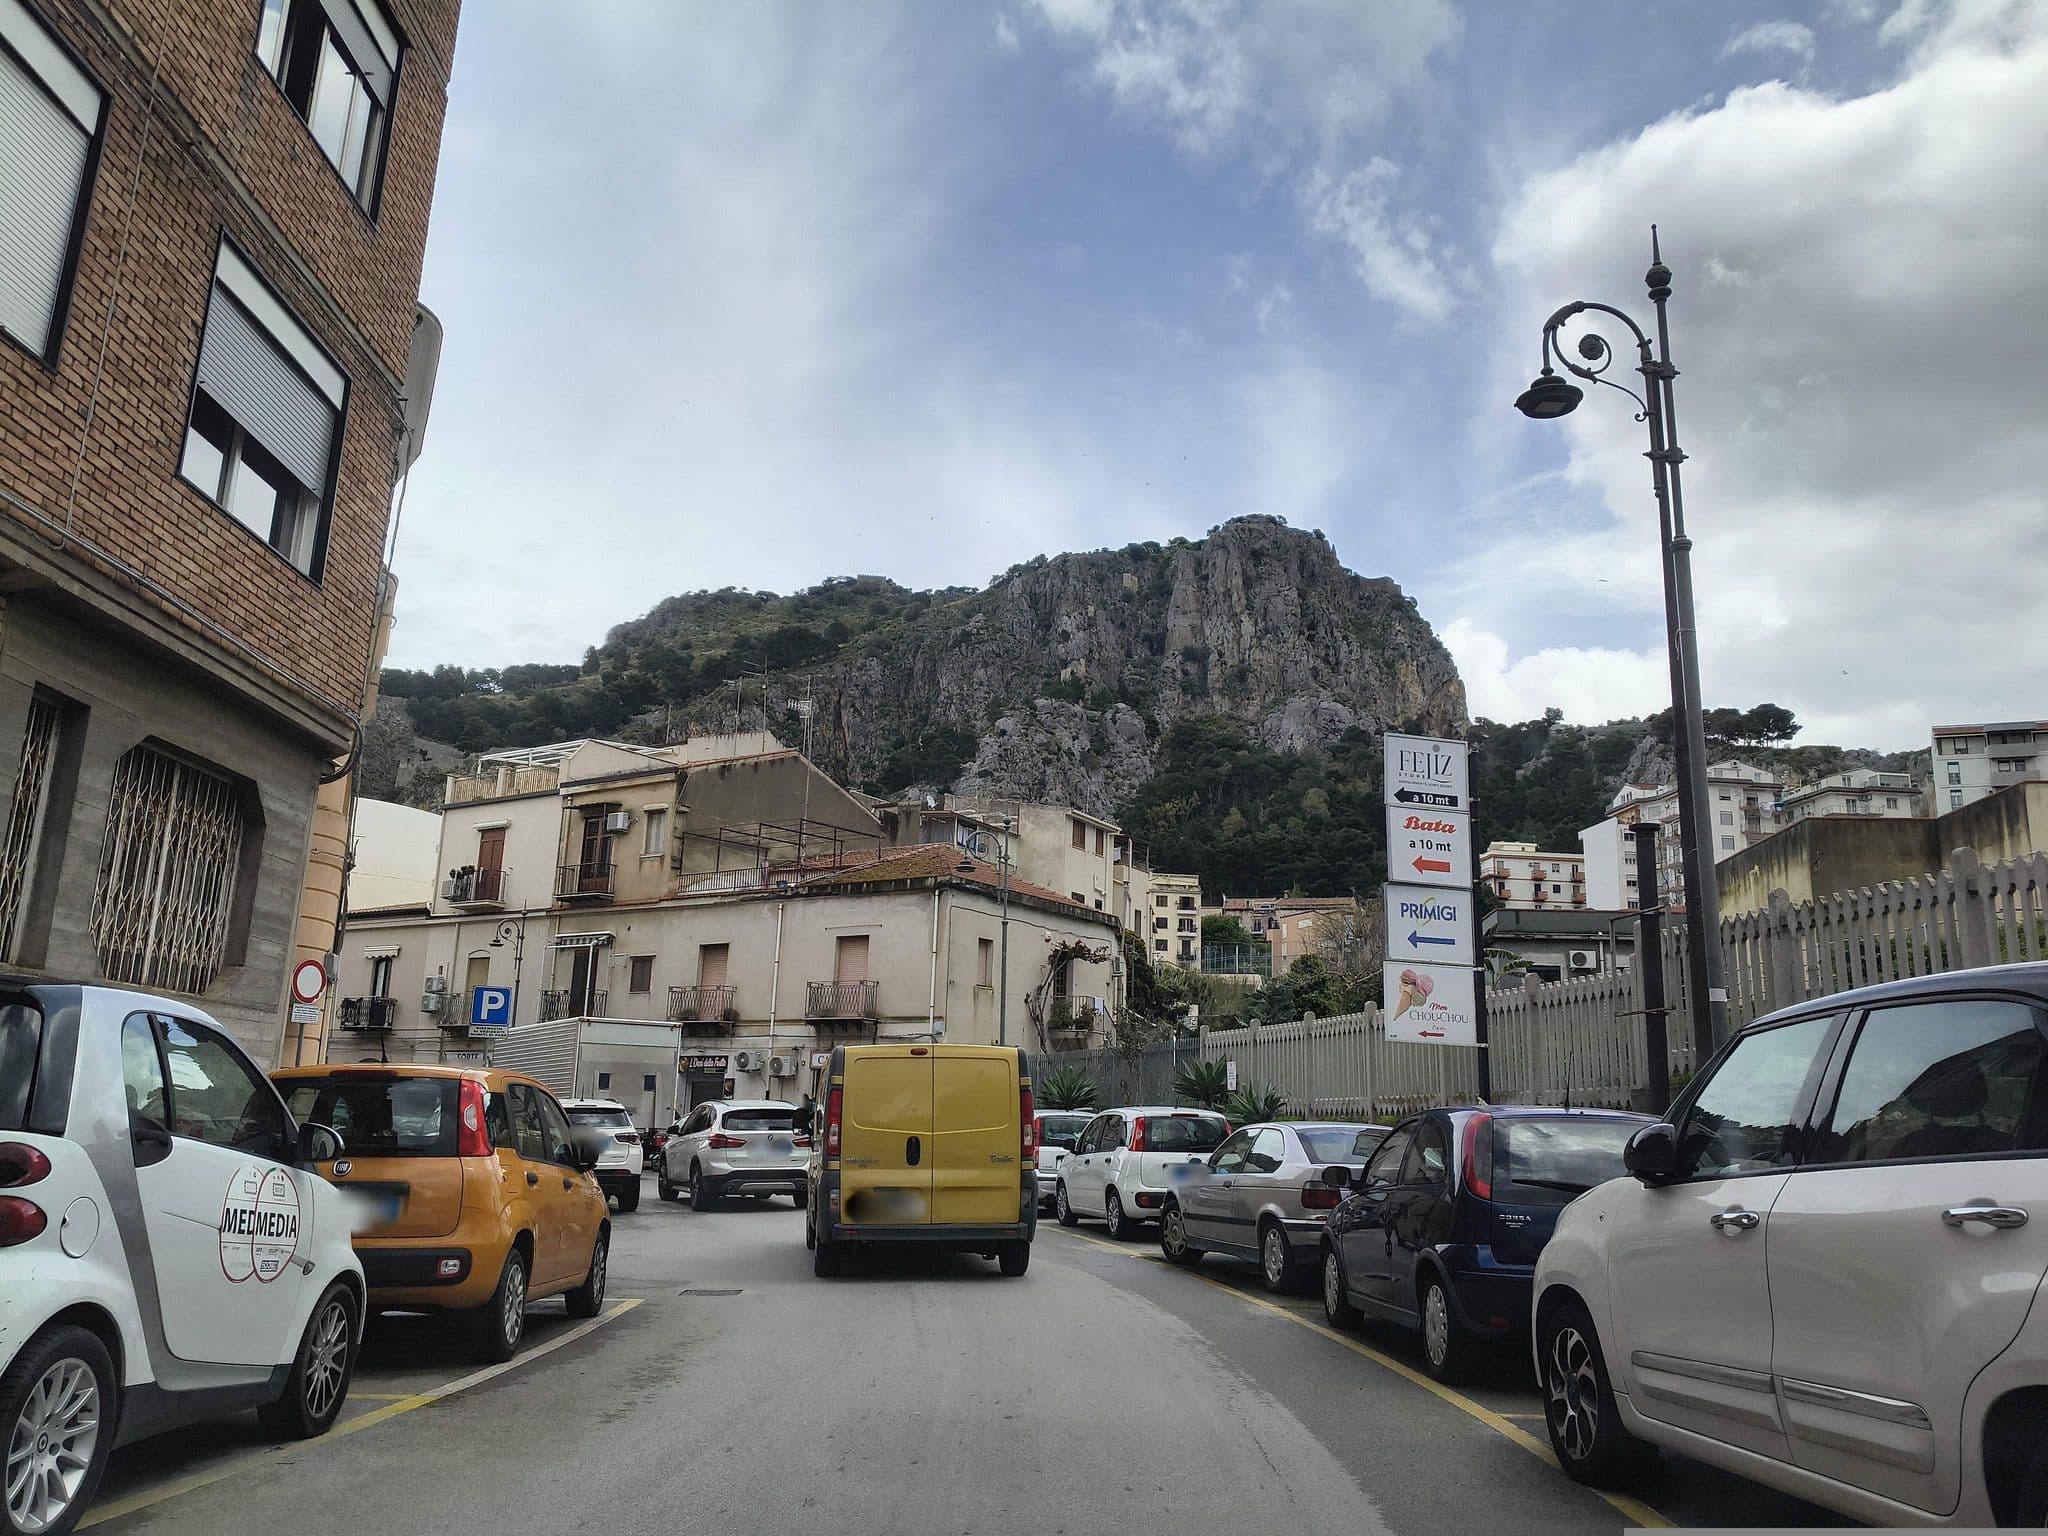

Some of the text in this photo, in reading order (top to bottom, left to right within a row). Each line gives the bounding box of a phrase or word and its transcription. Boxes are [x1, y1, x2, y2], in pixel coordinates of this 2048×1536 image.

[1422, 794, 1433, 803] 10
[1436, 796, 1449, 805] mt
[1403, 815, 1456, 833] Bata
[1409, 839, 1452, 852] a 10 mt
[1400, 902, 1457, 922] PRIMIGI
[480, 991, 505, 1020] P
